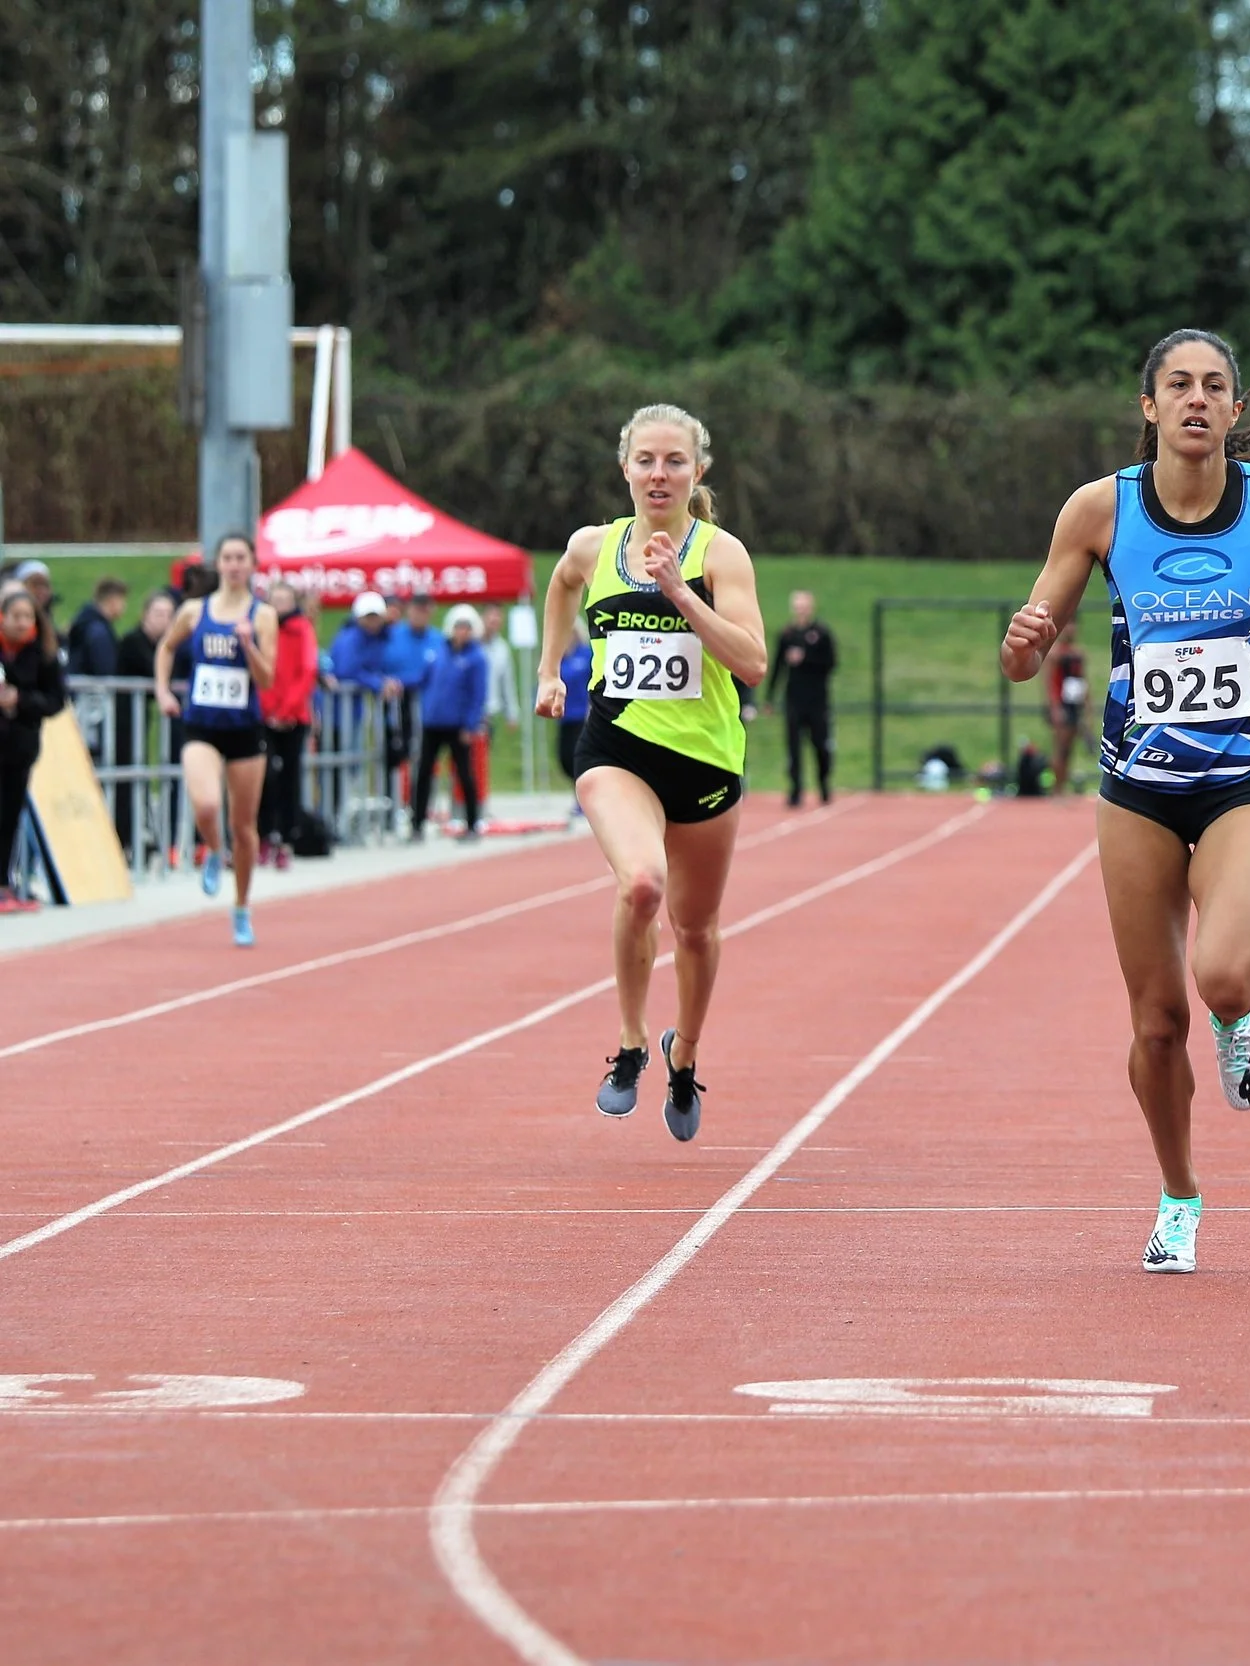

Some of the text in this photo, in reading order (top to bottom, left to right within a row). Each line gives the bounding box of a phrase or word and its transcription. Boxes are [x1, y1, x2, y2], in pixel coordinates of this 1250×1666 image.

[1140, 608, 1244, 623] ATHLETICS
[640, 637, 656, 645] SFU
[1174, 646, 1197, 657] SFU
[612, 653, 690, 691] 929
[1143, 664, 1241, 713] 925
